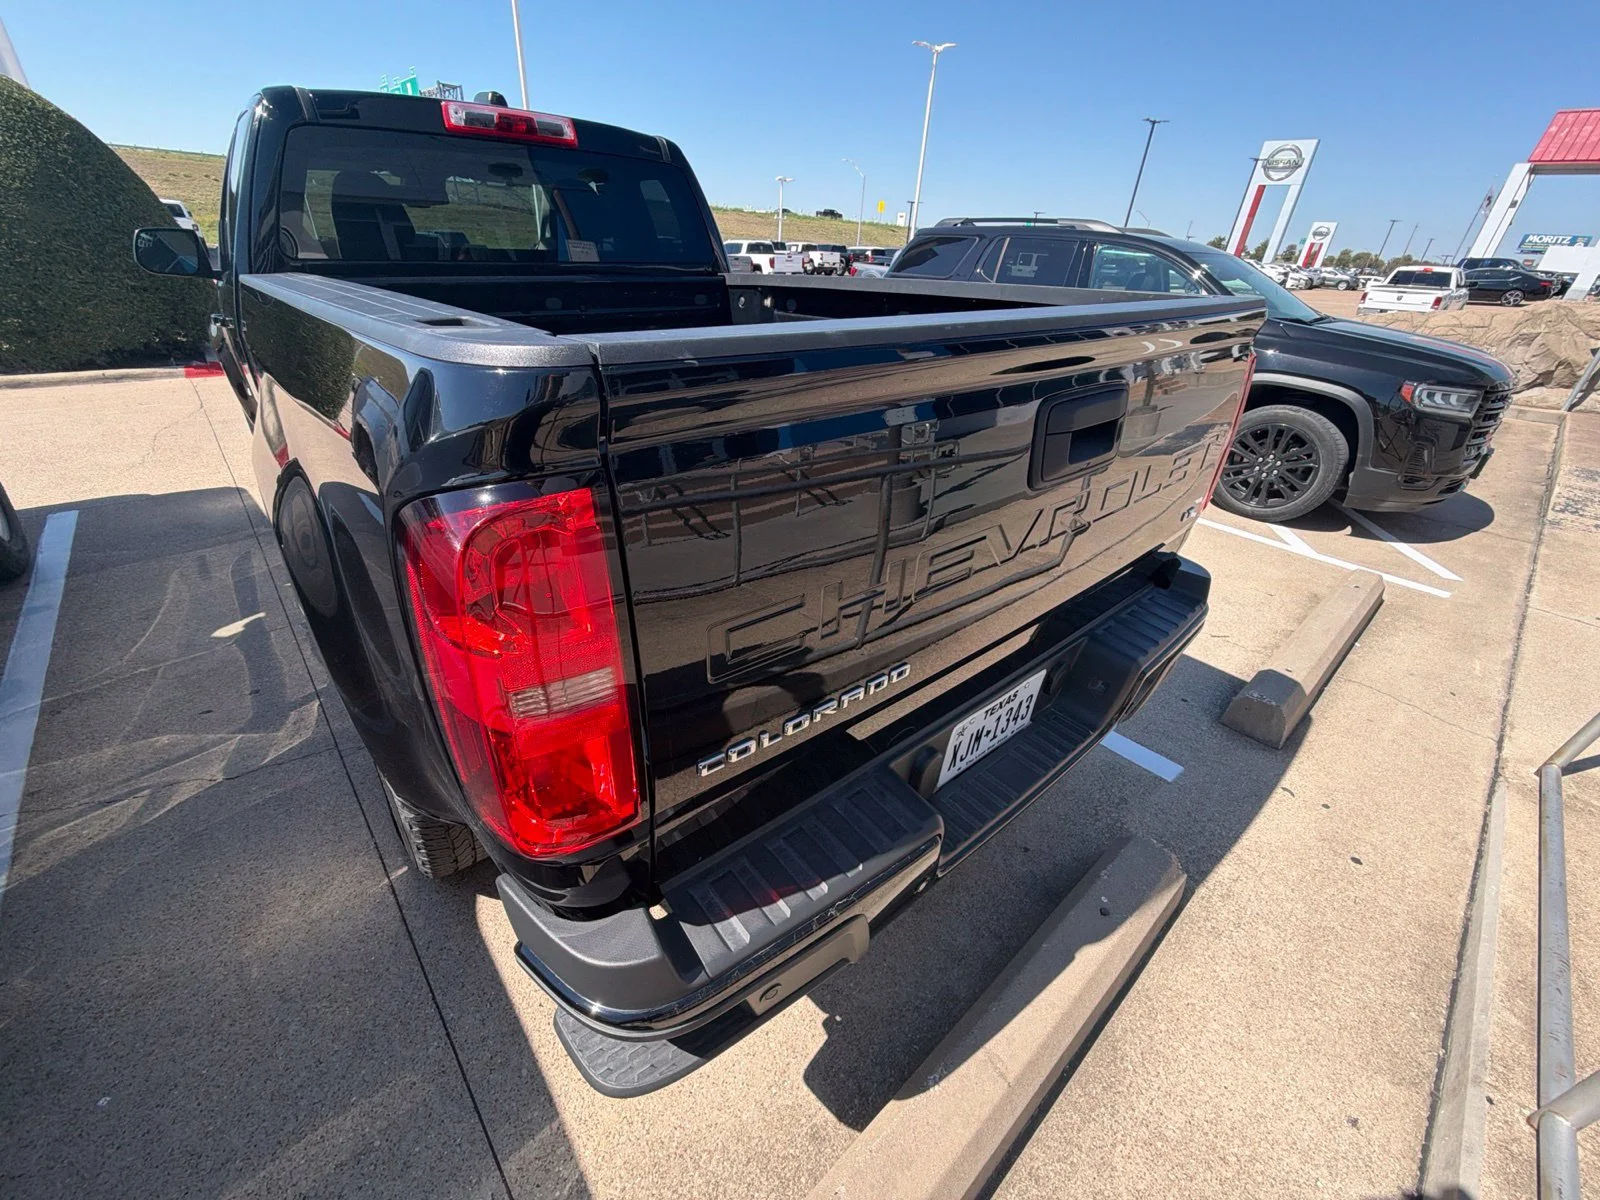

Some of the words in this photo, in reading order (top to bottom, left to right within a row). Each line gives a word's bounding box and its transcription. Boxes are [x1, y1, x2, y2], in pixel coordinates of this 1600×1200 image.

[1525, 234, 1573, 244] MORITZ
[706, 430, 1222, 684] CHEVROLET
[697, 662, 911, 777] COLORADO
[983, 690, 1019, 720] TEXAS
